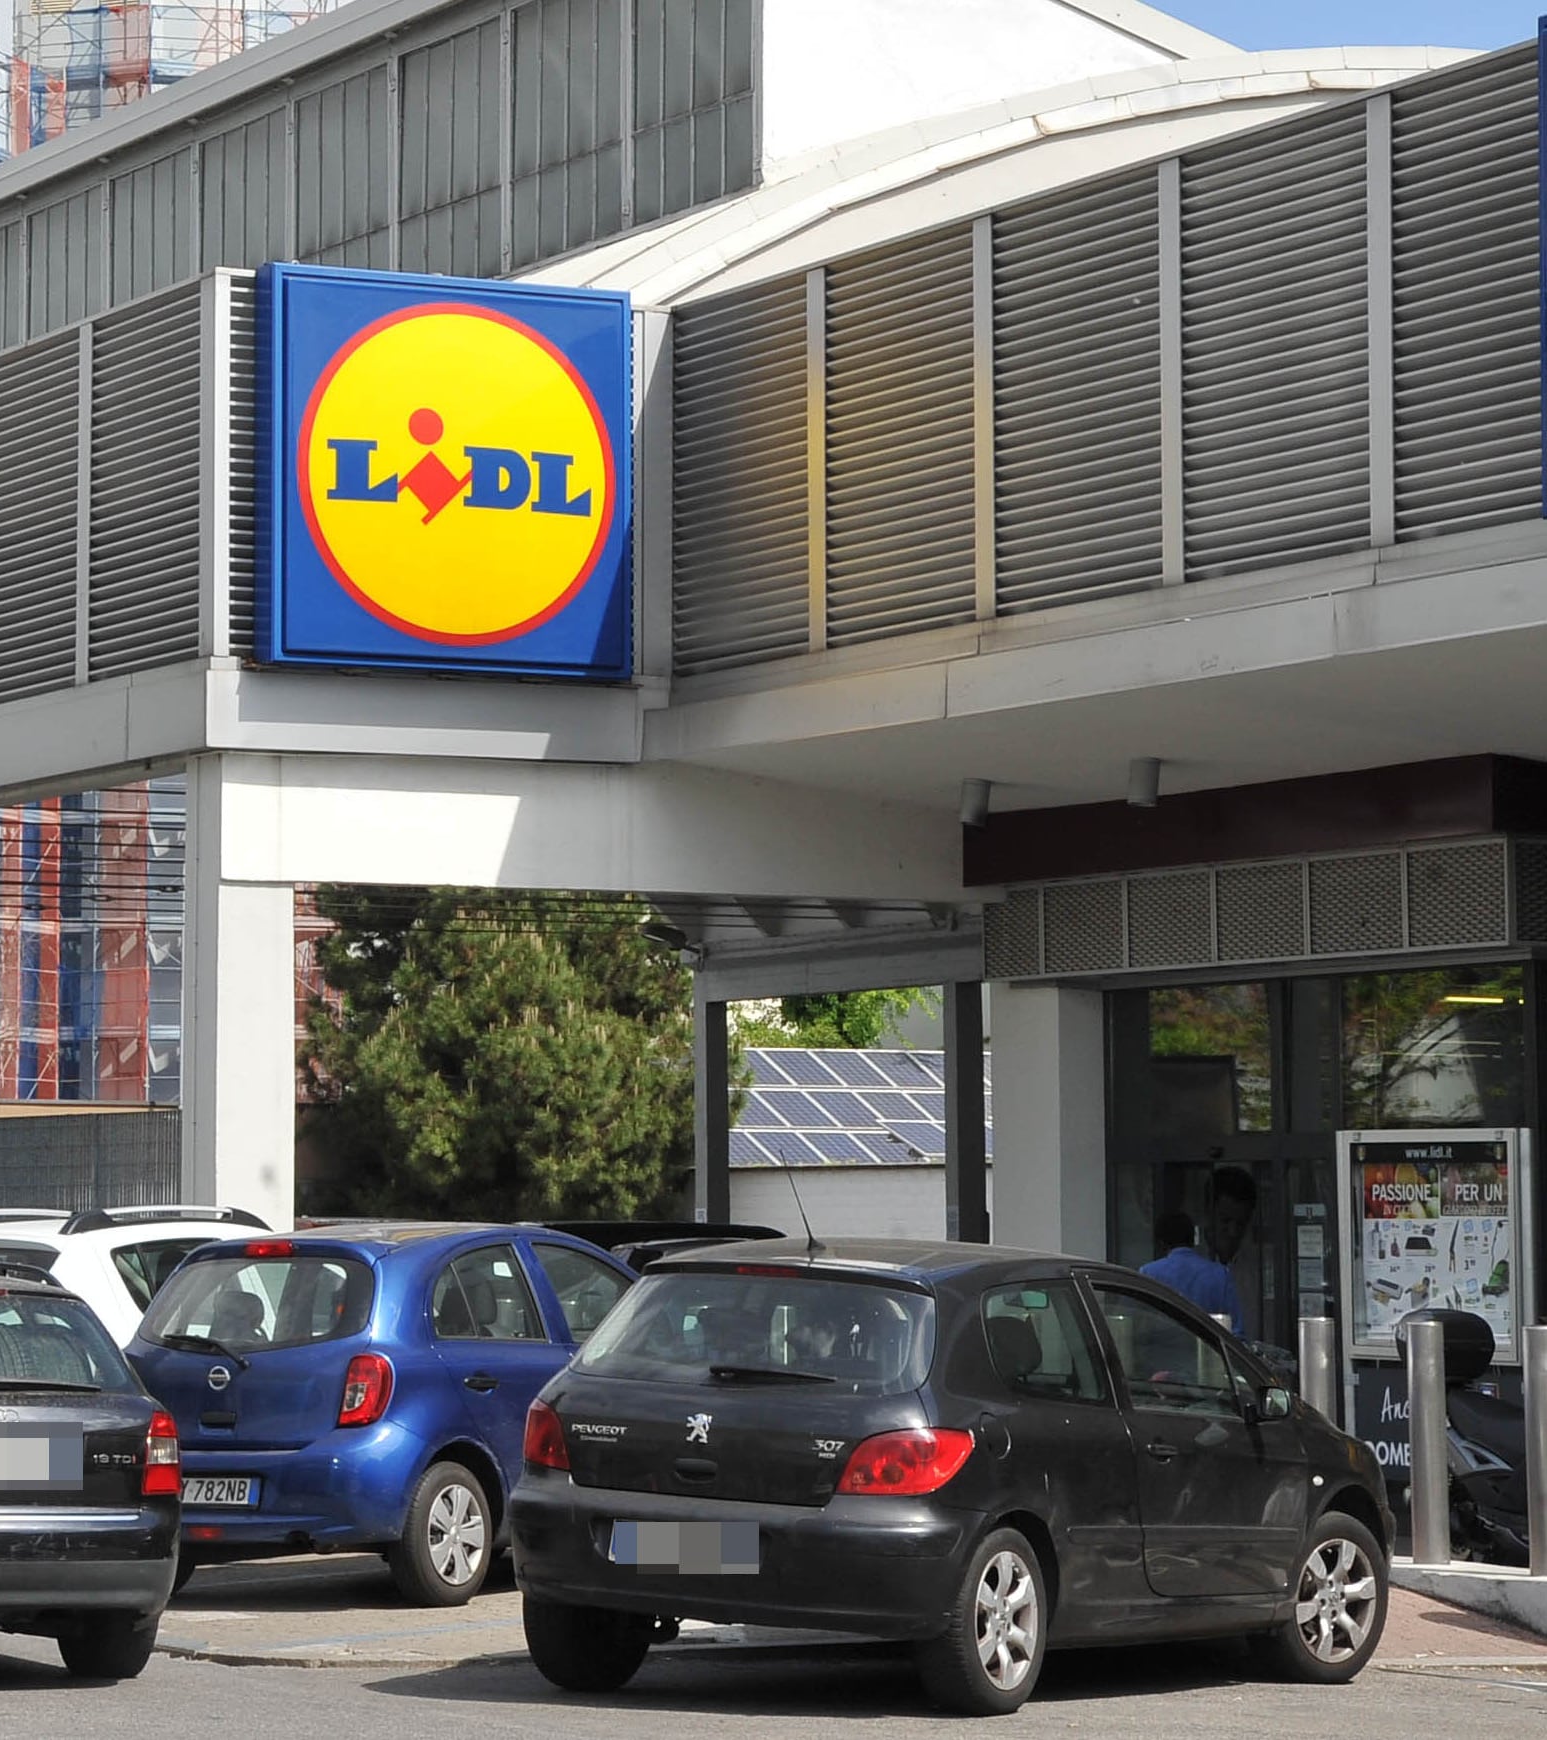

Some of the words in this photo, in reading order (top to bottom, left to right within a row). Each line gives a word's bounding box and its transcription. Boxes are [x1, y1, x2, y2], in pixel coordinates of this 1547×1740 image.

[1372, 1184, 1431, 1200] PASSIONE
[1455, 1184, 1478, 1200] PER
[1484, 1184, 1502, 1200] UN
[571, 1424, 627, 1435] PEUGEOT
[812, 1439, 845, 1452] 307
[194, 1480, 248, 1501] 782NB
